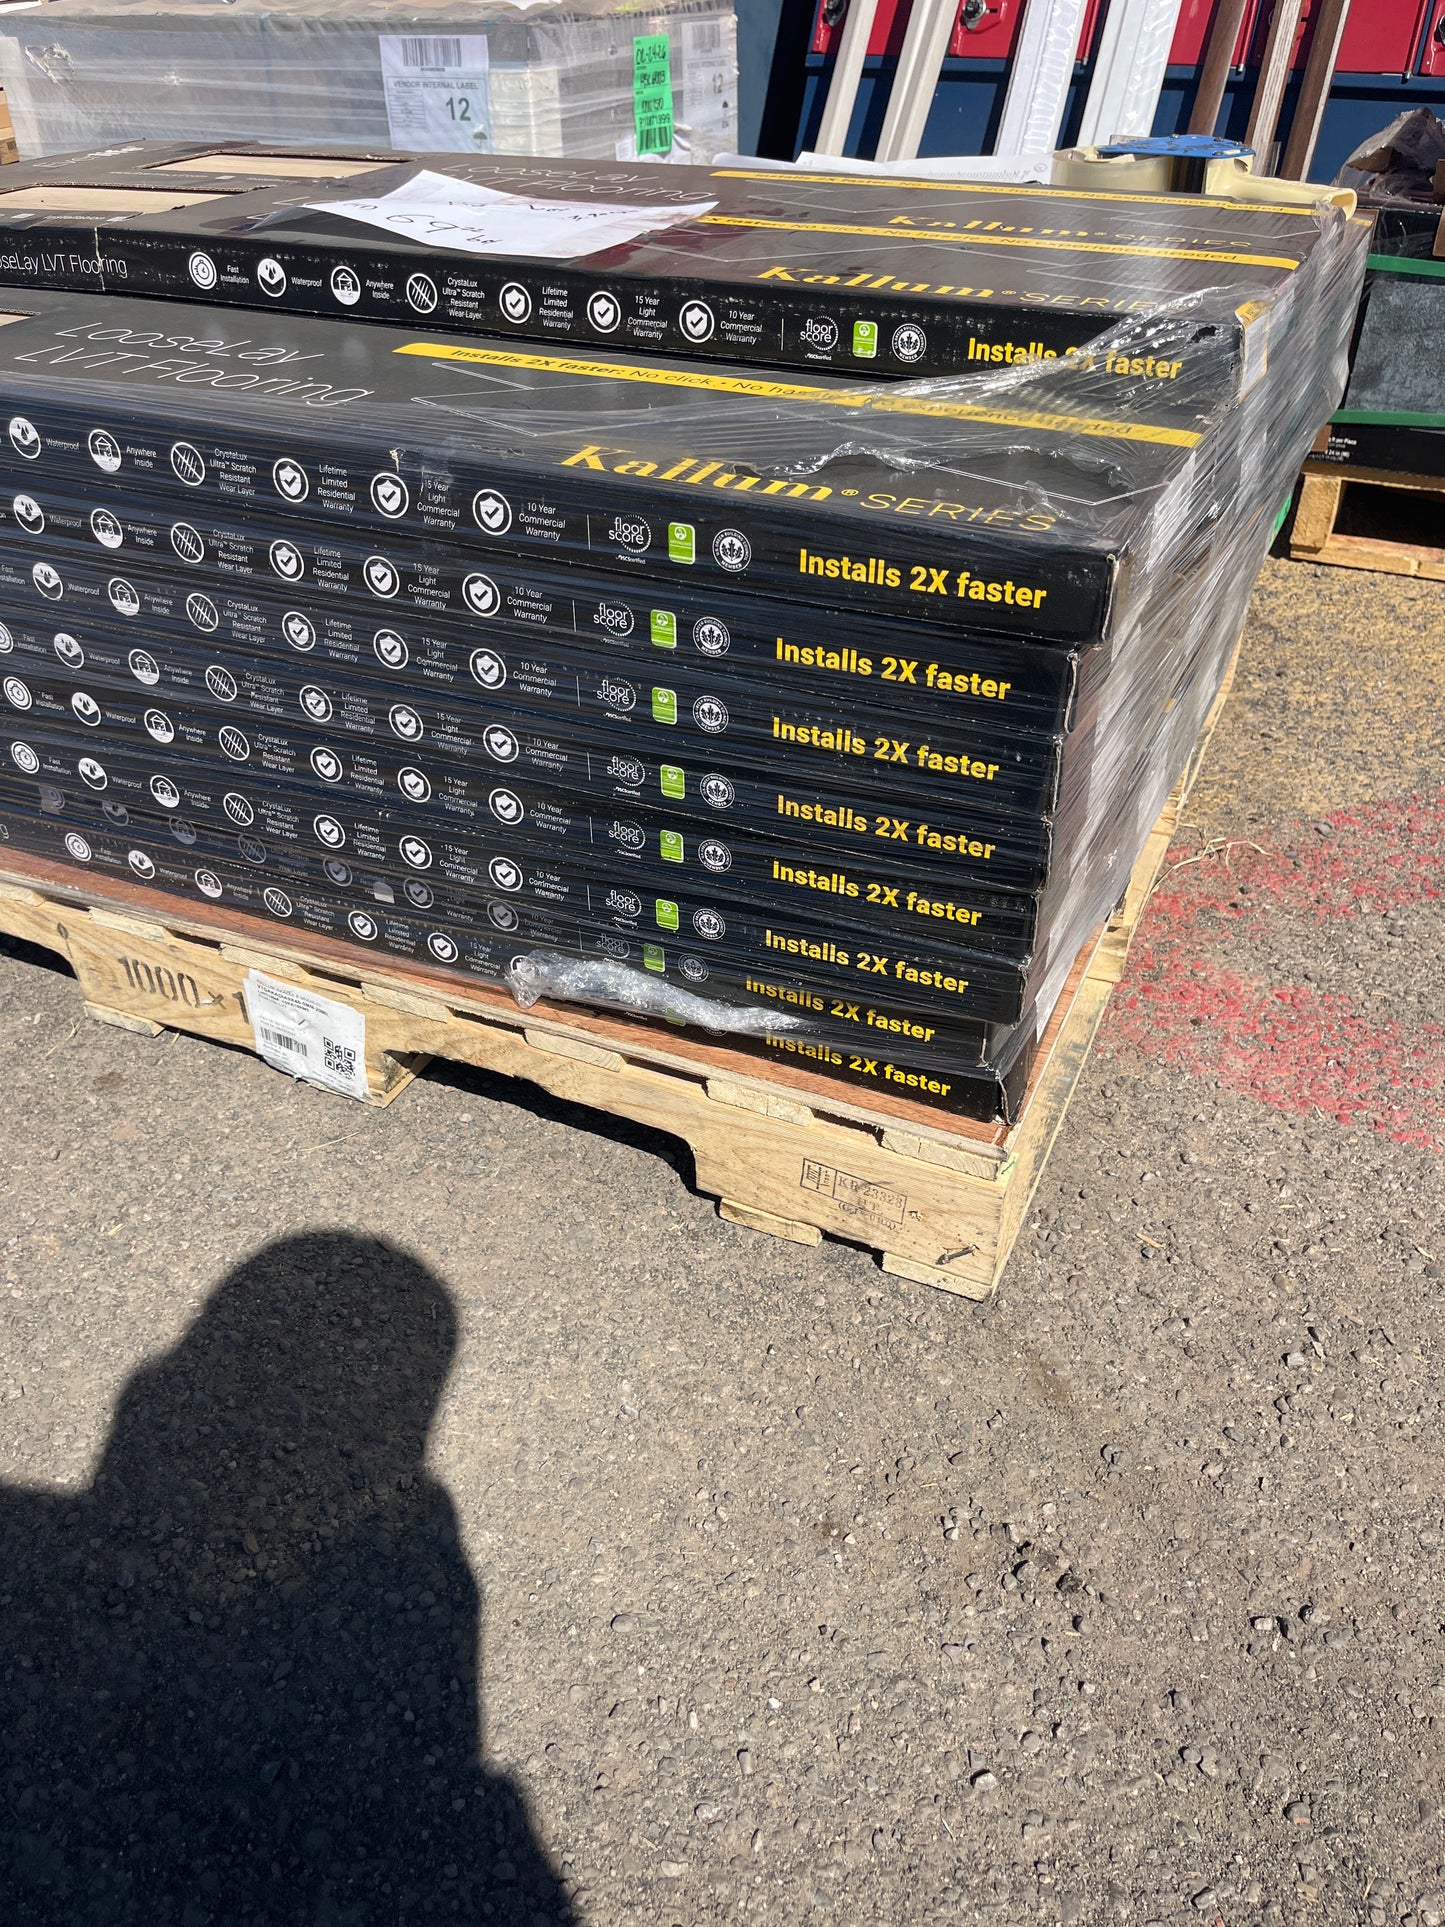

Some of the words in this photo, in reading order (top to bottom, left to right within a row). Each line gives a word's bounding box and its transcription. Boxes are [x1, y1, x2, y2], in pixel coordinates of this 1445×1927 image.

[446, 97, 471, 121] 12
[441, 163, 659, 183] LooseLay
[517, 180, 716, 201] Flooring
[41, 253, 65, 271] LVT
[71, 254, 128, 279] Flooring
[226, 265, 239, 274] Fast
[220, 274, 250, 285] Installation
[291, 276, 323, 288] Waterproof
[365, 279, 394, 291] Anywhere
[447, 277, 478, 288] CrystaLux
[372, 290, 391, 300] Inside
[462, 289, 486, 299] Scratch
[542, 286, 568, 297] Lifetime
[450, 299, 479, 309] Resistant
[543, 297, 568, 308] Limited
[635, 295, 642, 304] 15
[643, 296, 660, 306] Year
[538, 307, 574, 319] Residential
[638, 307, 656, 317] Light
[728, 310, 737, 319] 10
[738, 311, 755, 321] Year
[543, 319, 571, 330] Warranty
[627, 317, 668, 328] Commercial
[720, 321, 762, 333] Commercial
[805, 319, 833, 334] floor
[633, 328, 663, 340] Warranty
[726, 332, 757, 345] Warranty
[800, 331, 831, 343] score
[55, 322, 325, 367] LooseLay
[968, 337, 1056, 367] Installs
[1105, 350, 1183, 380] faster
[15, 345, 150, 368] LVT
[123, 359, 375, 407] Flooring
[450, 350, 523, 364] Installs
[525, 358, 555, 367] 2X
[558, 361, 626, 375] faster:
[629, 370, 659, 379] No
[733, 381, 772, 392] No
[46, 438, 80, 450] Waterproof
[126, 445, 157, 458] Anywhere
[214, 448, 248, 461] CrystaLux
[134, 458, 154, 469] Inside
[231, 462, 257, 473] Scratch
[319, 464, 348, 476] Lifetime
[220, 471, 251, 484] Resistant
[322, 477, 348, 488] Limited
[219, 482, 237, 493] Wear
[237, 485, 256, 496] Layer
[433, 480, 449, 491] Year
[317, 487, 355, 501] Residential
[428, 493, 446, 504] Light
[322, 500, 353, 513] Warranty
[417, 502, 460, 517] Commercial
[527, 502, 537, 512] 10
[538, 503, 556, 515] Year
[860, 493, 1058, 531] SERIES
[423, 516, 456, 530] Warranty
[519, 514, 566, 529] Commercial
[614, 516, 645, 537] floor
[525, 527, 561, 541] Warranty
[608, 529, 644, 545] score
[313, 546, 341, 558] Lifetime
[317, 558, 342, 568] Limited
[413, 563, 422, 571] 15
[423, 564, 440, 575] Year
[312, 568, 350, 581] Residential
[419, 575, 437, 585] Light
[800, 548, 902, 587] Installs
[909, 565, 949, 595] 2X
[957, 571, 1047, 609] faster
[318, 579, 348, 592] Warranty
[407, 584, 450, 598] Commercial
[515, 586, 524, 595] 10
[526, 587, 543, 599] Year
[414, 596, 447, 610] Warranty
[507, 596, 552, 612] Commercial
[513, 609, 548, 624] Warranty
[598, 602, 629, 622] floor
[593, 614, 627, 629] score
[521, 662, 529, 670] 10
[531, 663, 548, 674] Year
[776, 637, 873, 676] Installs
[881, 657, 918, 684] 2X
[926, 664, 1011, 700] faster
[513, 671, 557, 686] Commercial
[519, 683, 552, 697] Warranty
[772, 716, 866, 755] Installs
[874, 737, 910, 764] 2X
[917, 745, 999, 781] faster
[611, 756, 639, 774] floor
[607, 765, 639, 780] score
[777, 794, 868, 833] Installs
[875, 816, 910, 842] 2X
[917, 825, 996, 860] faster
[609, 889, 636, 907] floor
[772, 861, 860, 898] Installs
[866, 883, 899, 908] 2X
[907, 891, 982, 926] faster
[605, 897, 636, 912] score
[765, 929, 850, 965] Installs
[857, 951, 889, 976] 2X
[895, 961, 969, 994] faster
[117, 956, 201, 1008] 1000
[745, 976, 825, 1011] Installs
[830, 1000, 861, 1022] 2X
[866, 1008, 935, 1042] faster
[765, 1031, 844, 1065] Installs
[849, 1055, 878, 1076] 2X
[884, 1063, 951, 1097] faster
